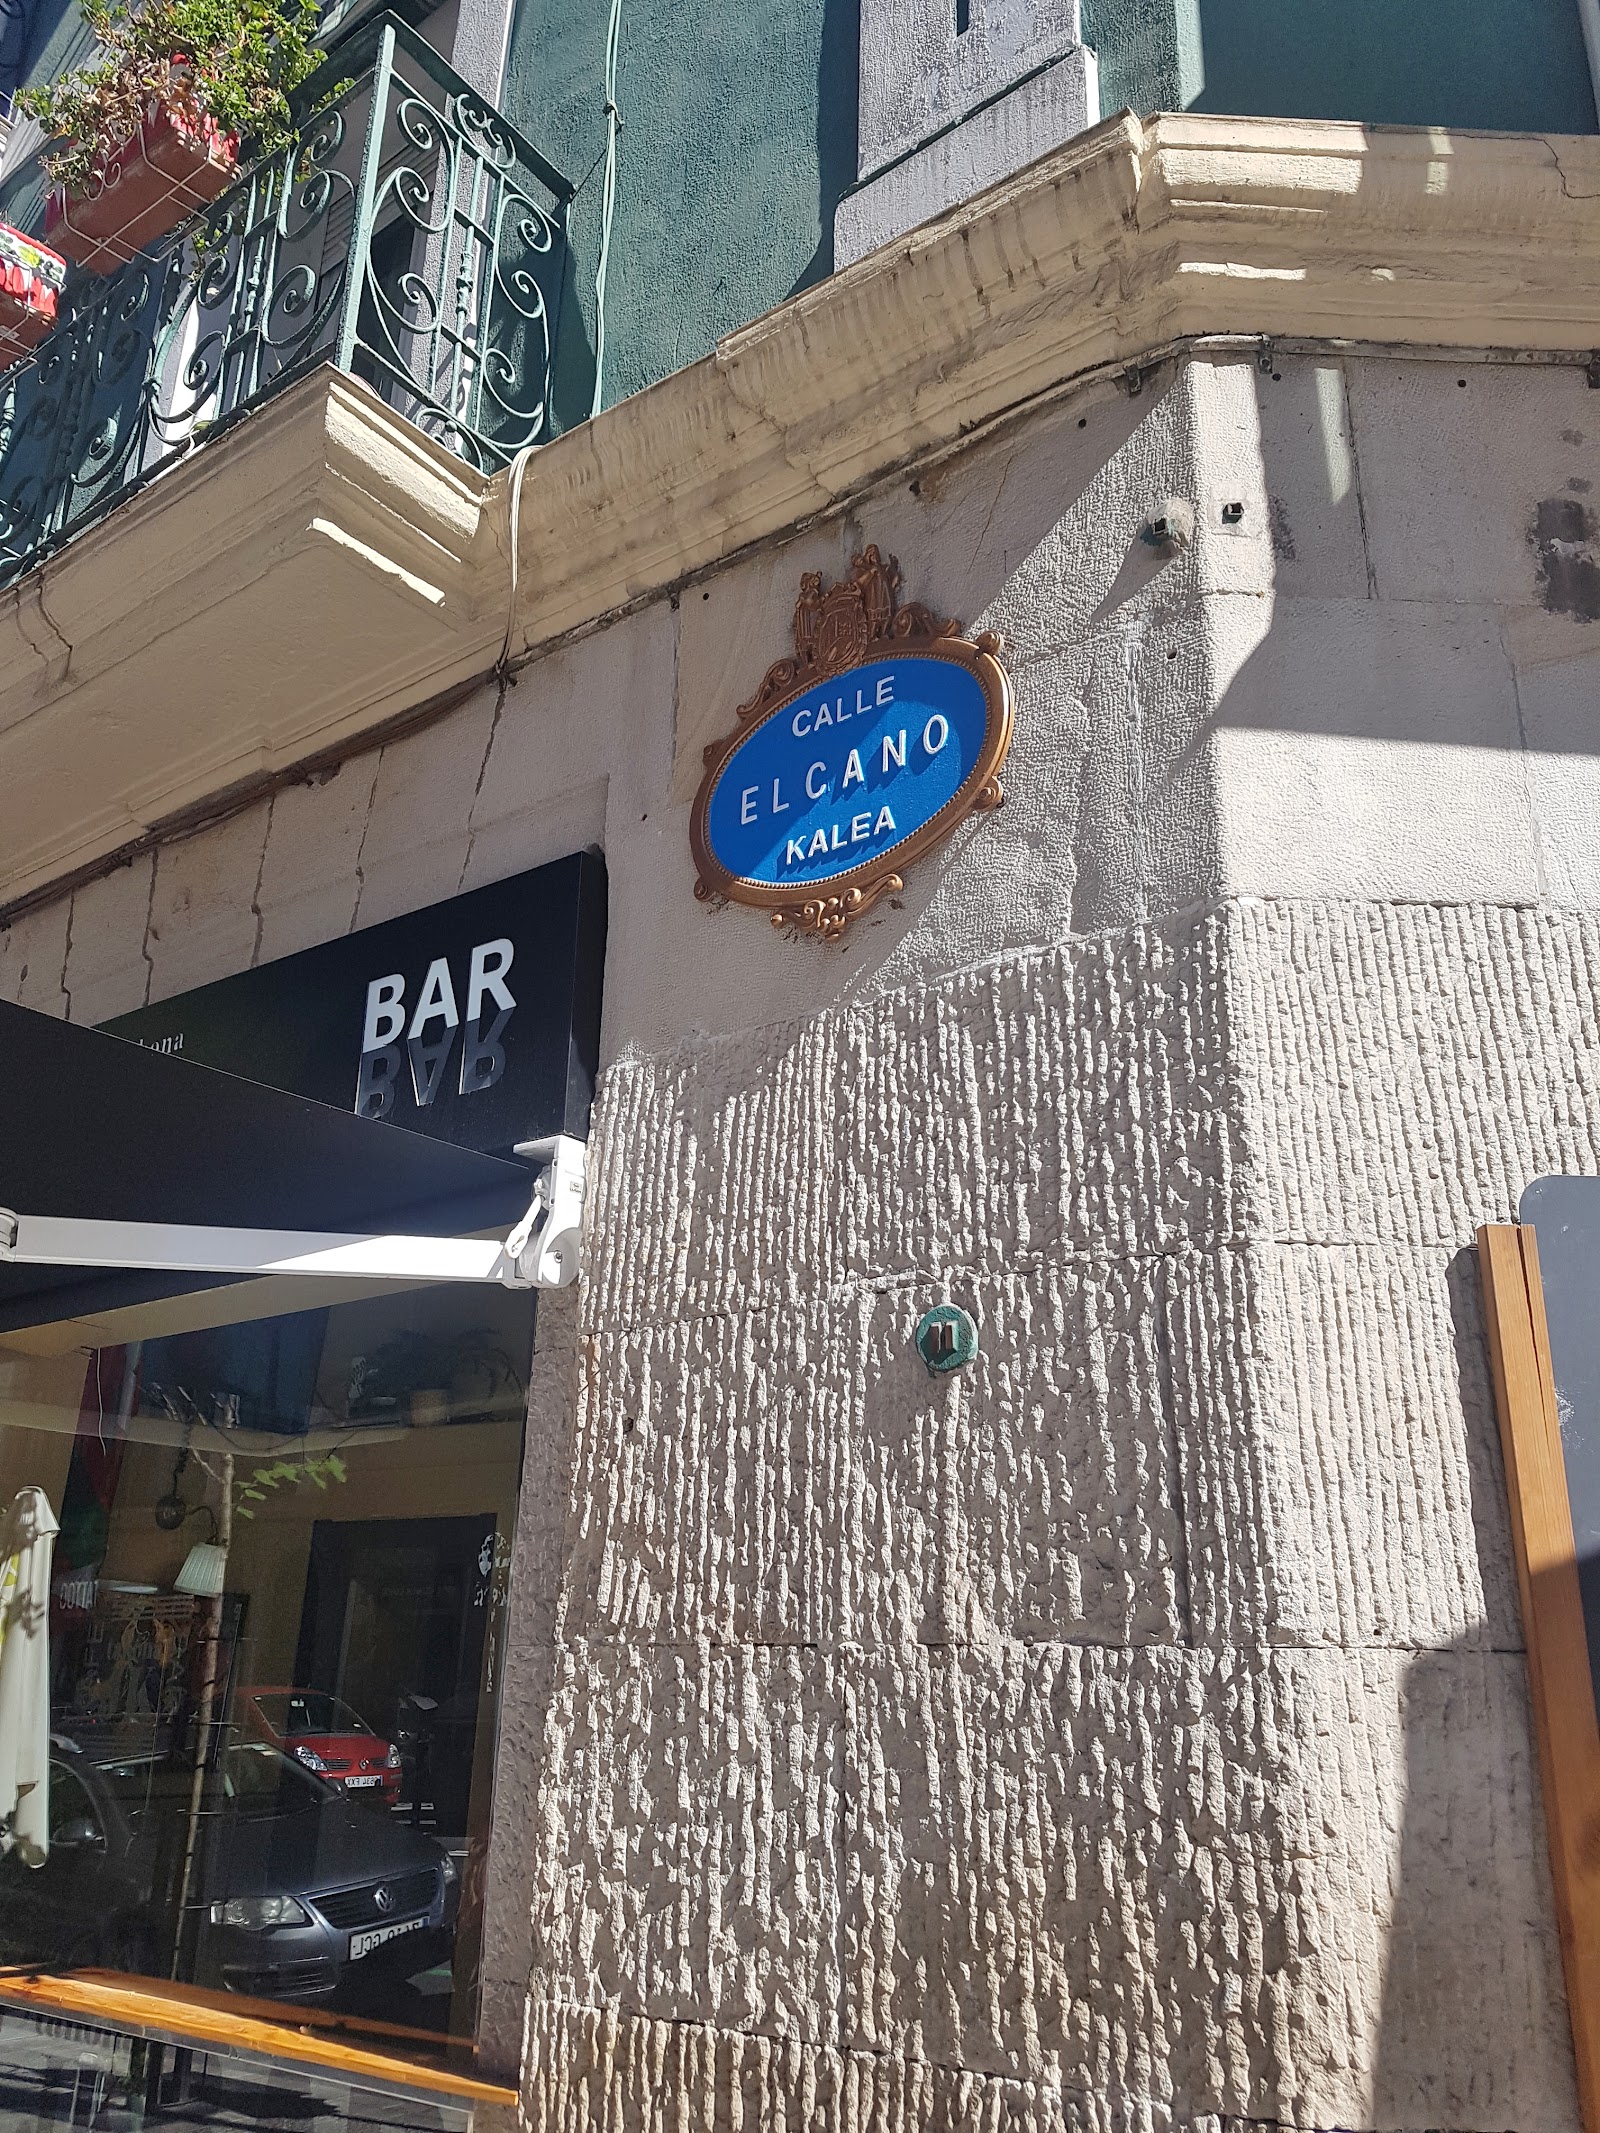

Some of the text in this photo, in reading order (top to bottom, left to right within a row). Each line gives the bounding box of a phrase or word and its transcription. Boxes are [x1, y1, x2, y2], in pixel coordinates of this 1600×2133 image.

[792, 675, 895, 737] CALLE
[740, 714, 949, 825] ELCANO
[786, 805, 896, 865] KALEA
[362, 938, 518, 1053] BAR
